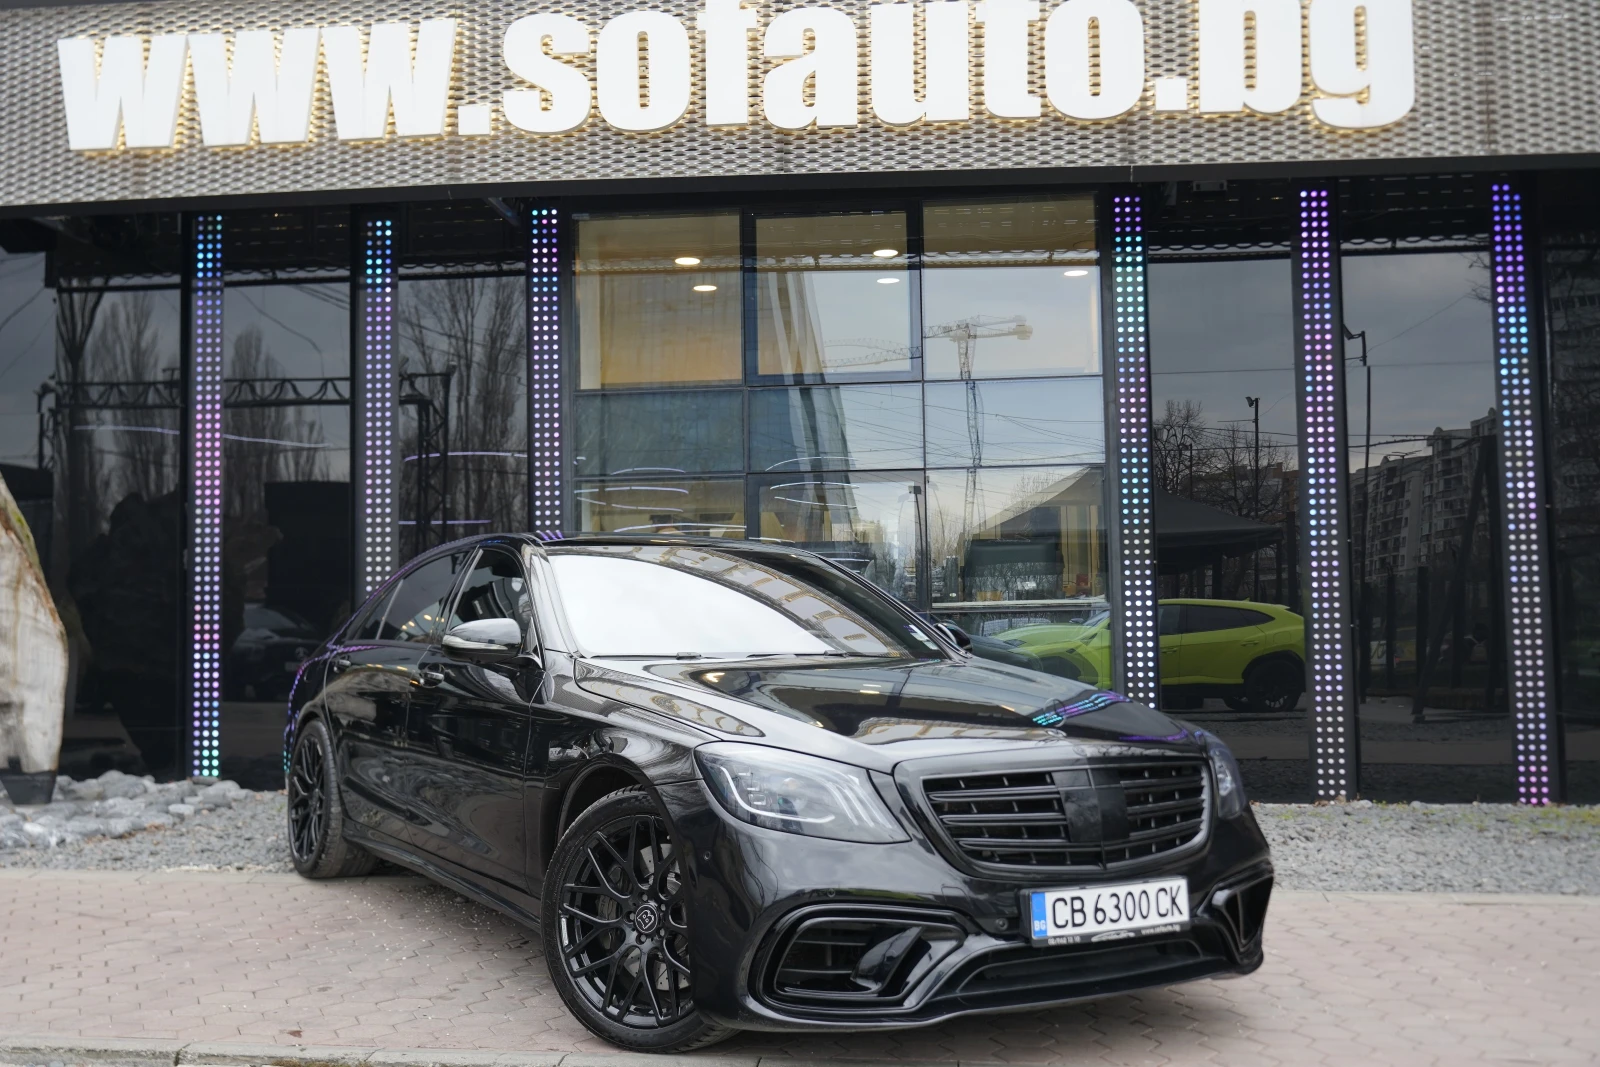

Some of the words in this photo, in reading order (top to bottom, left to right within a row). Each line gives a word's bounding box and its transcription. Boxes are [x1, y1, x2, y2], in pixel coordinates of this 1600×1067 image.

[57, 0, 1415, 150] www.sofauto.bg
[1034, 919, 1046, 931] BG
[1052, 896, 1086, 929] CB
[1094, 889, 1150, 925] 6300
[1156, 885, 1183, 917] CK
